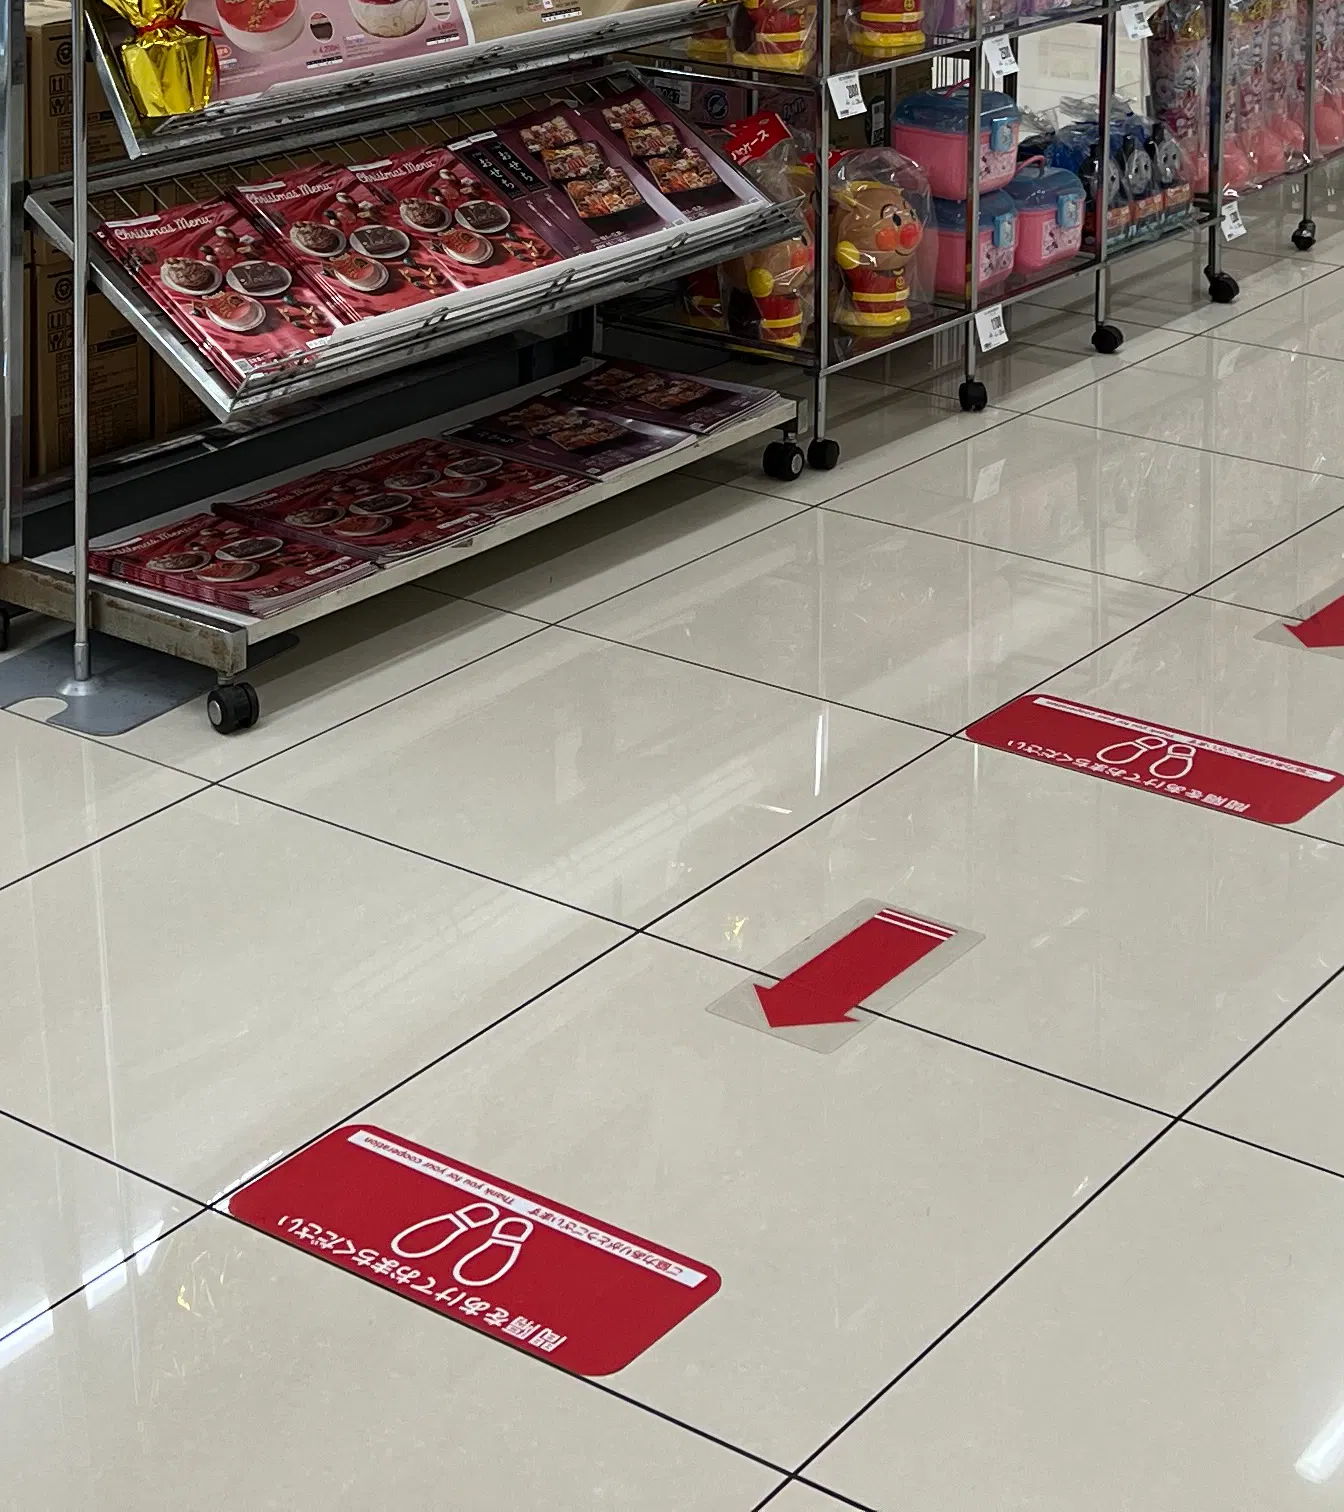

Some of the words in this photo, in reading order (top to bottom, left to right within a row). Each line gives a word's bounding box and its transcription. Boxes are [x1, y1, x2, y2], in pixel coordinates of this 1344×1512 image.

[356, 167, 405, 184] Christmas
[404, 158, 438, 175] Menu
[246, 189, 299, 205] Christmas
[297, 181, 333, 198] Menu
[114, 224, 175, 242] Christmas
[175, 215, 212, 234] Menu
[363, 1135, 422, 1162] cooperation
[422, 1160, 447, 1176] your
[463, 1178, 484, 1191] you
[485, 1190, 516, 1205] Thank
[277, 1215, 568, 1353] 間隔をあけておまちください
